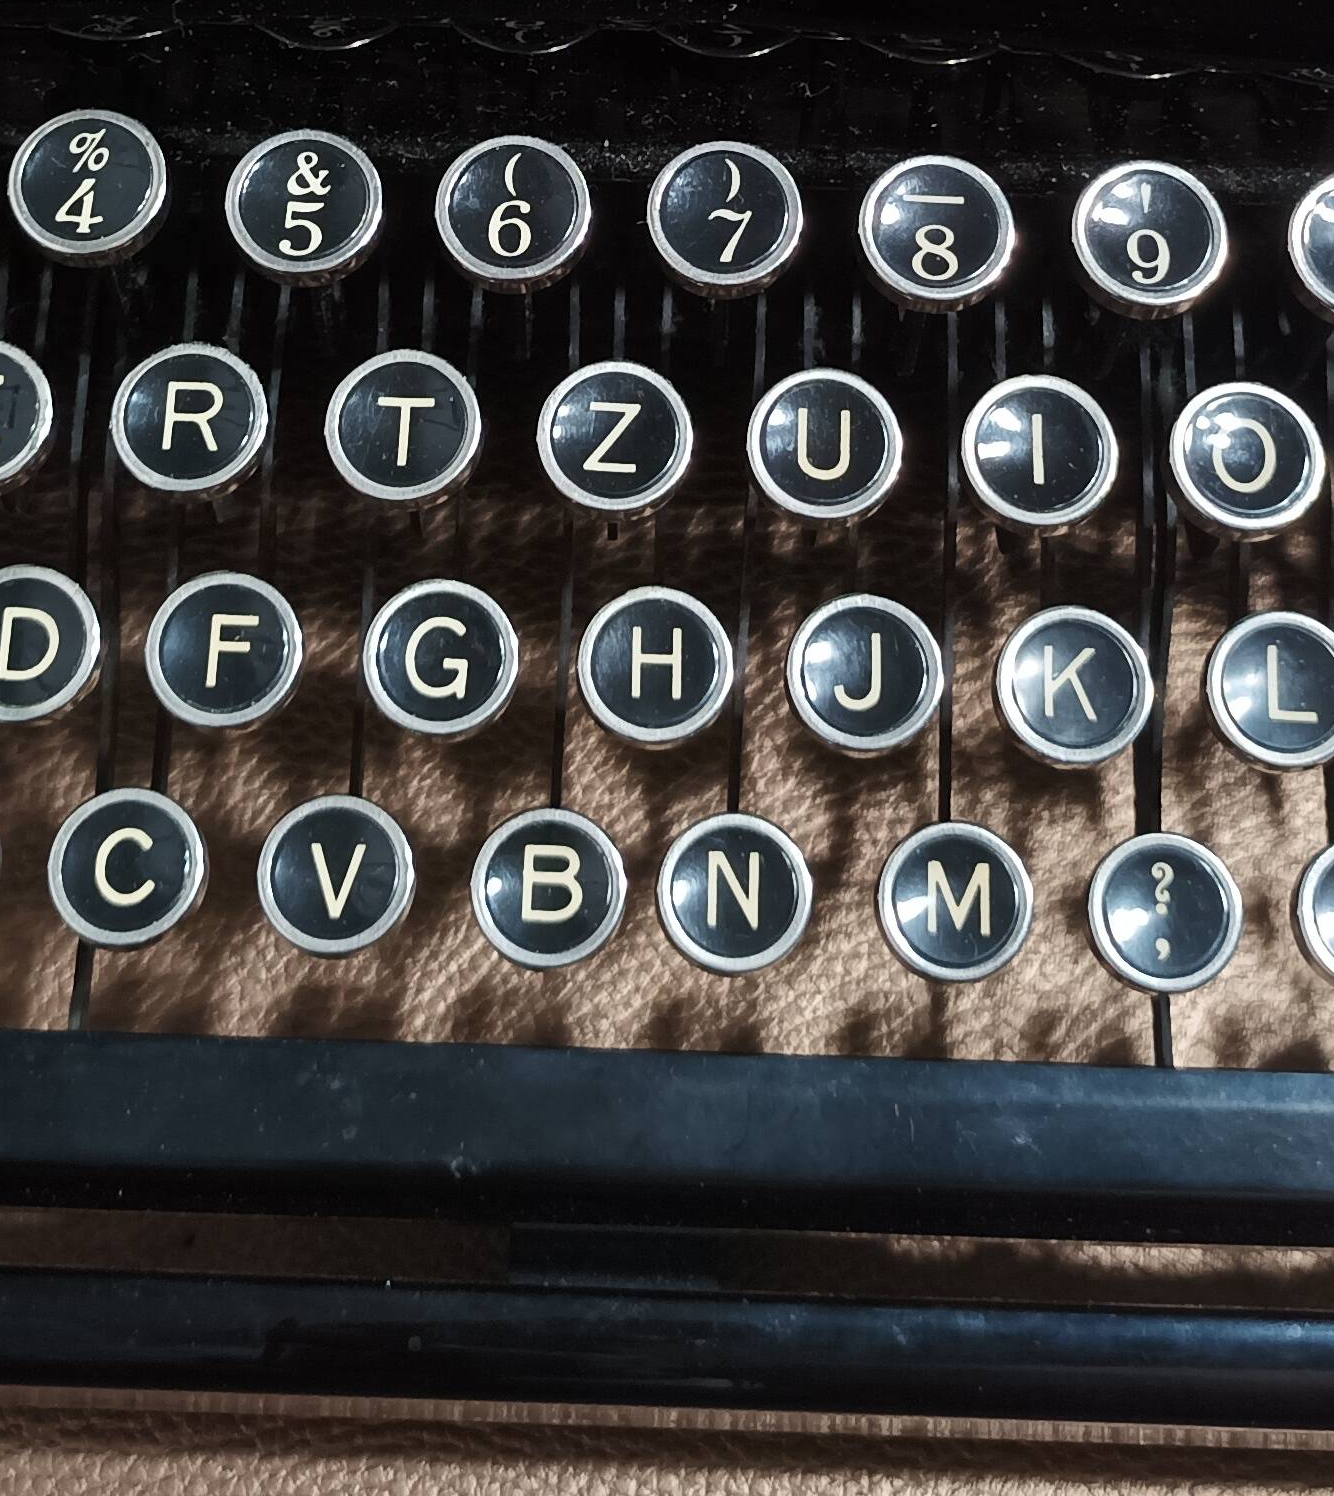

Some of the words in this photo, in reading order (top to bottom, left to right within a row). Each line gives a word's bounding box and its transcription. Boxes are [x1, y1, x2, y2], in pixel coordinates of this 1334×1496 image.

[68, 128, 110, 173] %
[286, 151, 332, 196] &
[54, 177, 104, 234] 4
[278, 200, 325, 257] 5
[487, 199, 532, 257] 6
[707, 208, 753, 263] 7
[911, 224, 959, 281] 8
[1126, 228, 1171, 285] 9
[162, 381, 224, 452] R
[377, 397, 435, 466] T
[583, 401, 641, 473] Z
[798, 408, 851, 481] U
[1032, 413, 1045, 484] I
[1212, 418, 1276, 493] O
[205, 614, 259, 688] F
[405, 617, 468, 699] G
[631, 626, 682, 700] H
[833, 632, 881, 711] J
[1042, 645, 1098, 722] K
[1267, 644, 1319, 723] L
[94, 827, 155, 906] C
[311, 842, 366, 919] V
[521, 844, 583, 923] B
[707, 850, 759, 931] N
[927, 860, 991, 938] M
[1151, 861, 1175, 915] ?
